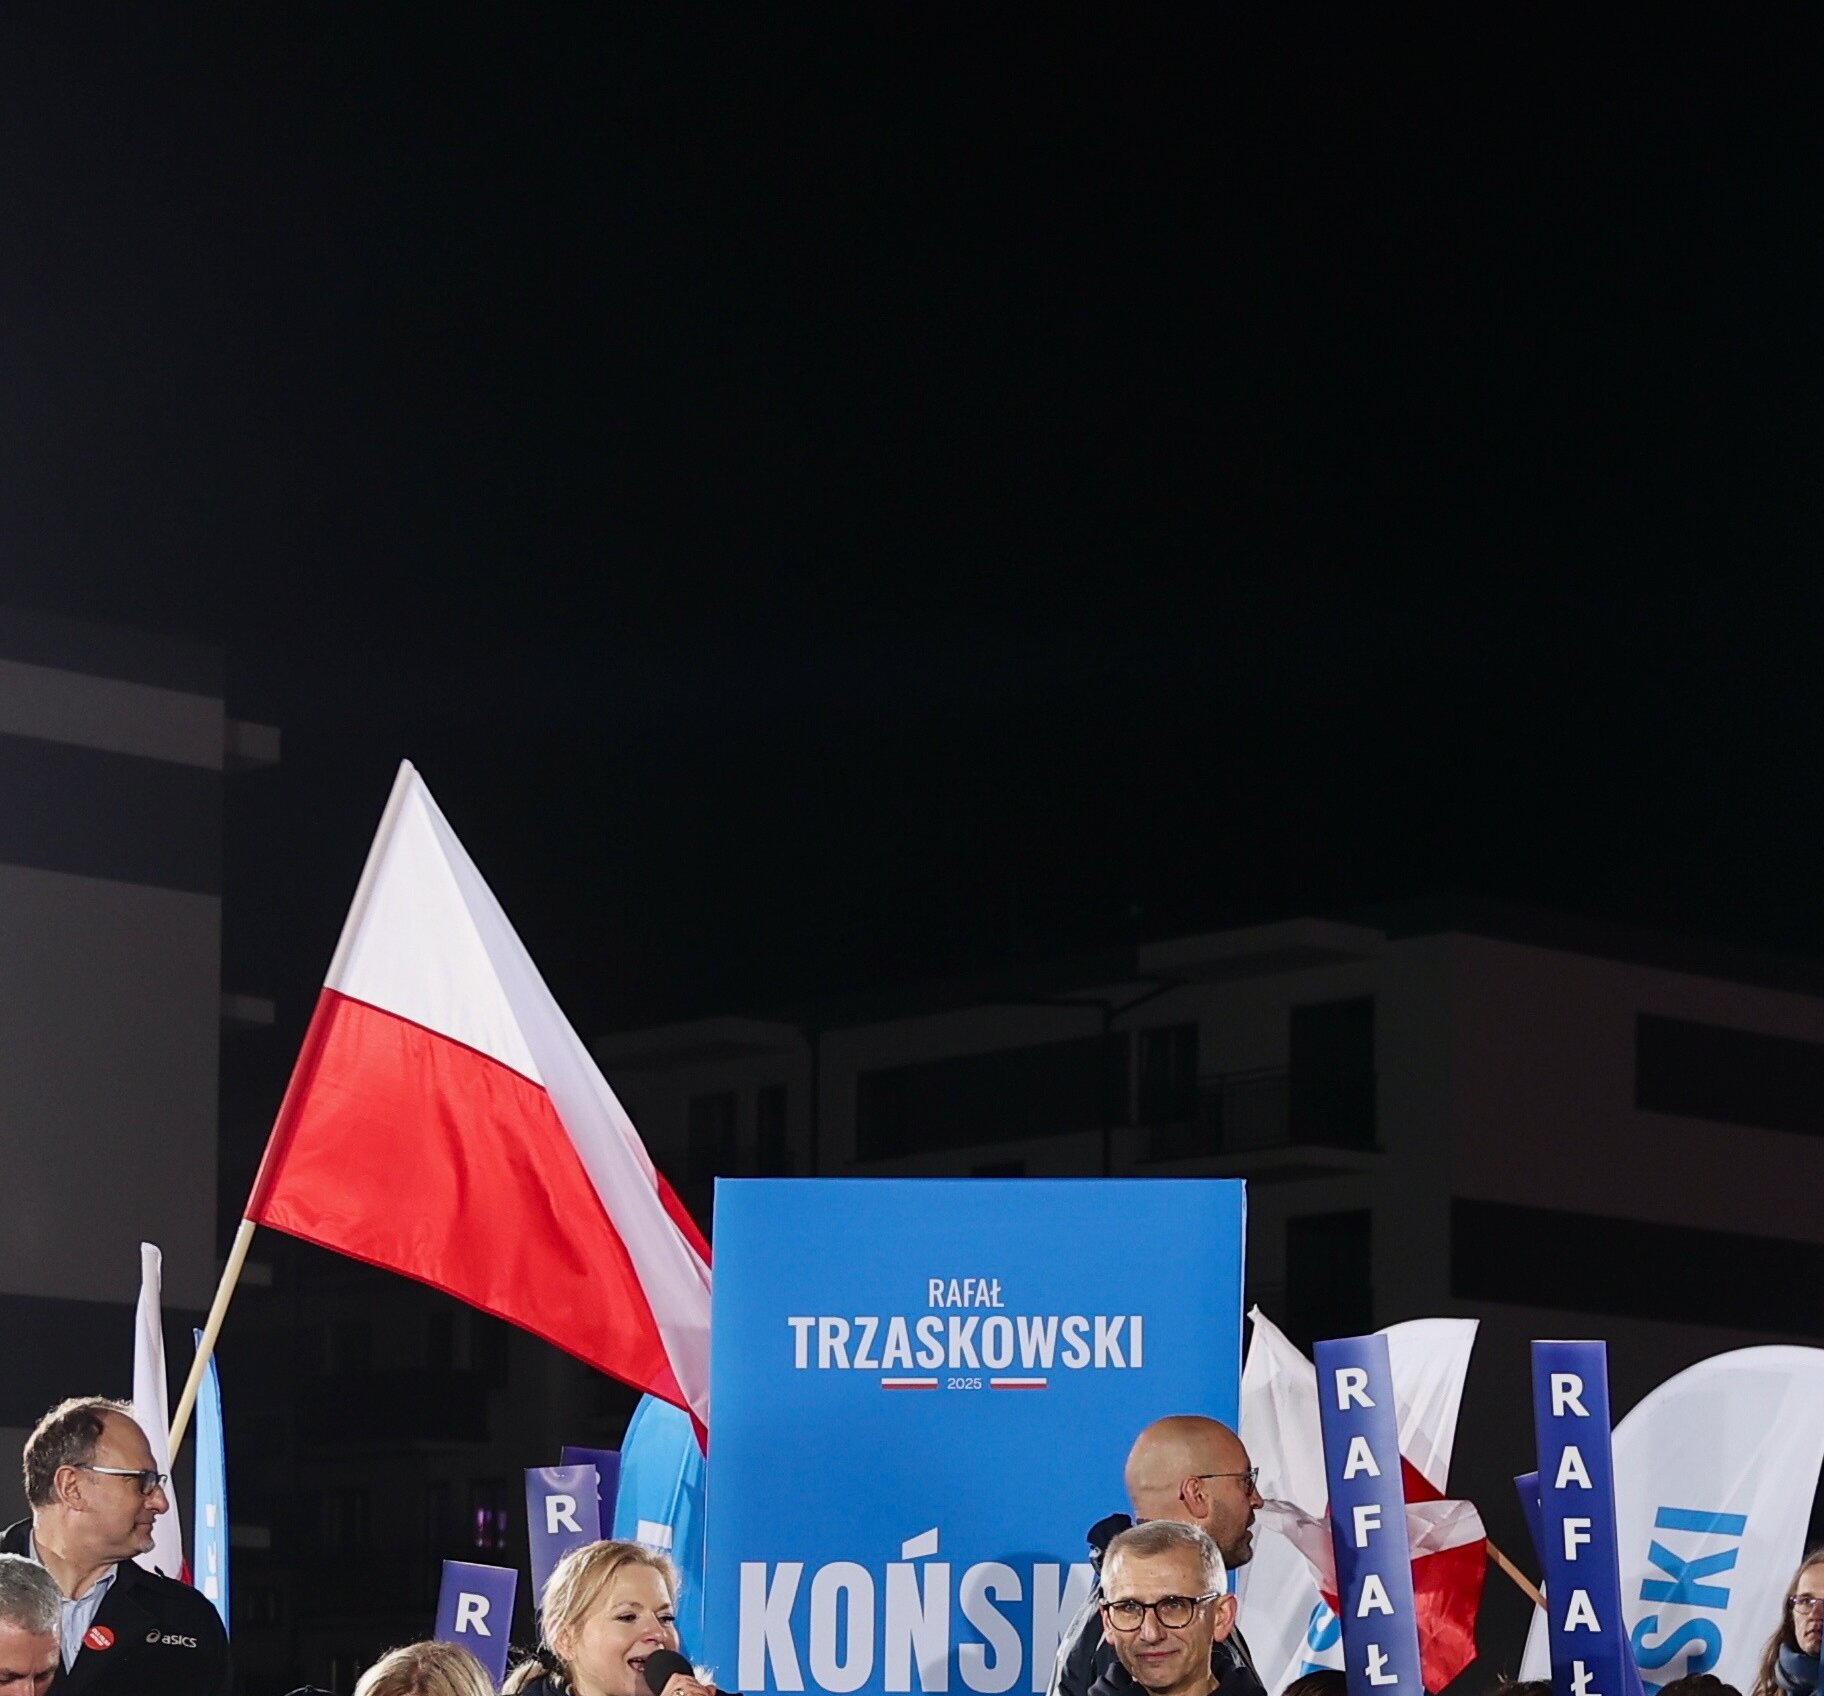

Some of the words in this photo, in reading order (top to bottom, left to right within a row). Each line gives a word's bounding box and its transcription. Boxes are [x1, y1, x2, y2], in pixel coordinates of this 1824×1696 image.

[927, 1277, 1005, 1309] RAFAŁ
[787, 1315, 1144, 1370] TRZASKOWSKI
[946, 1377, 983, 1391] 2025
[1334, 1366, 1399, 1688] RAFAŁ
[738, 1528, 1095, 1694] KOŃSK
